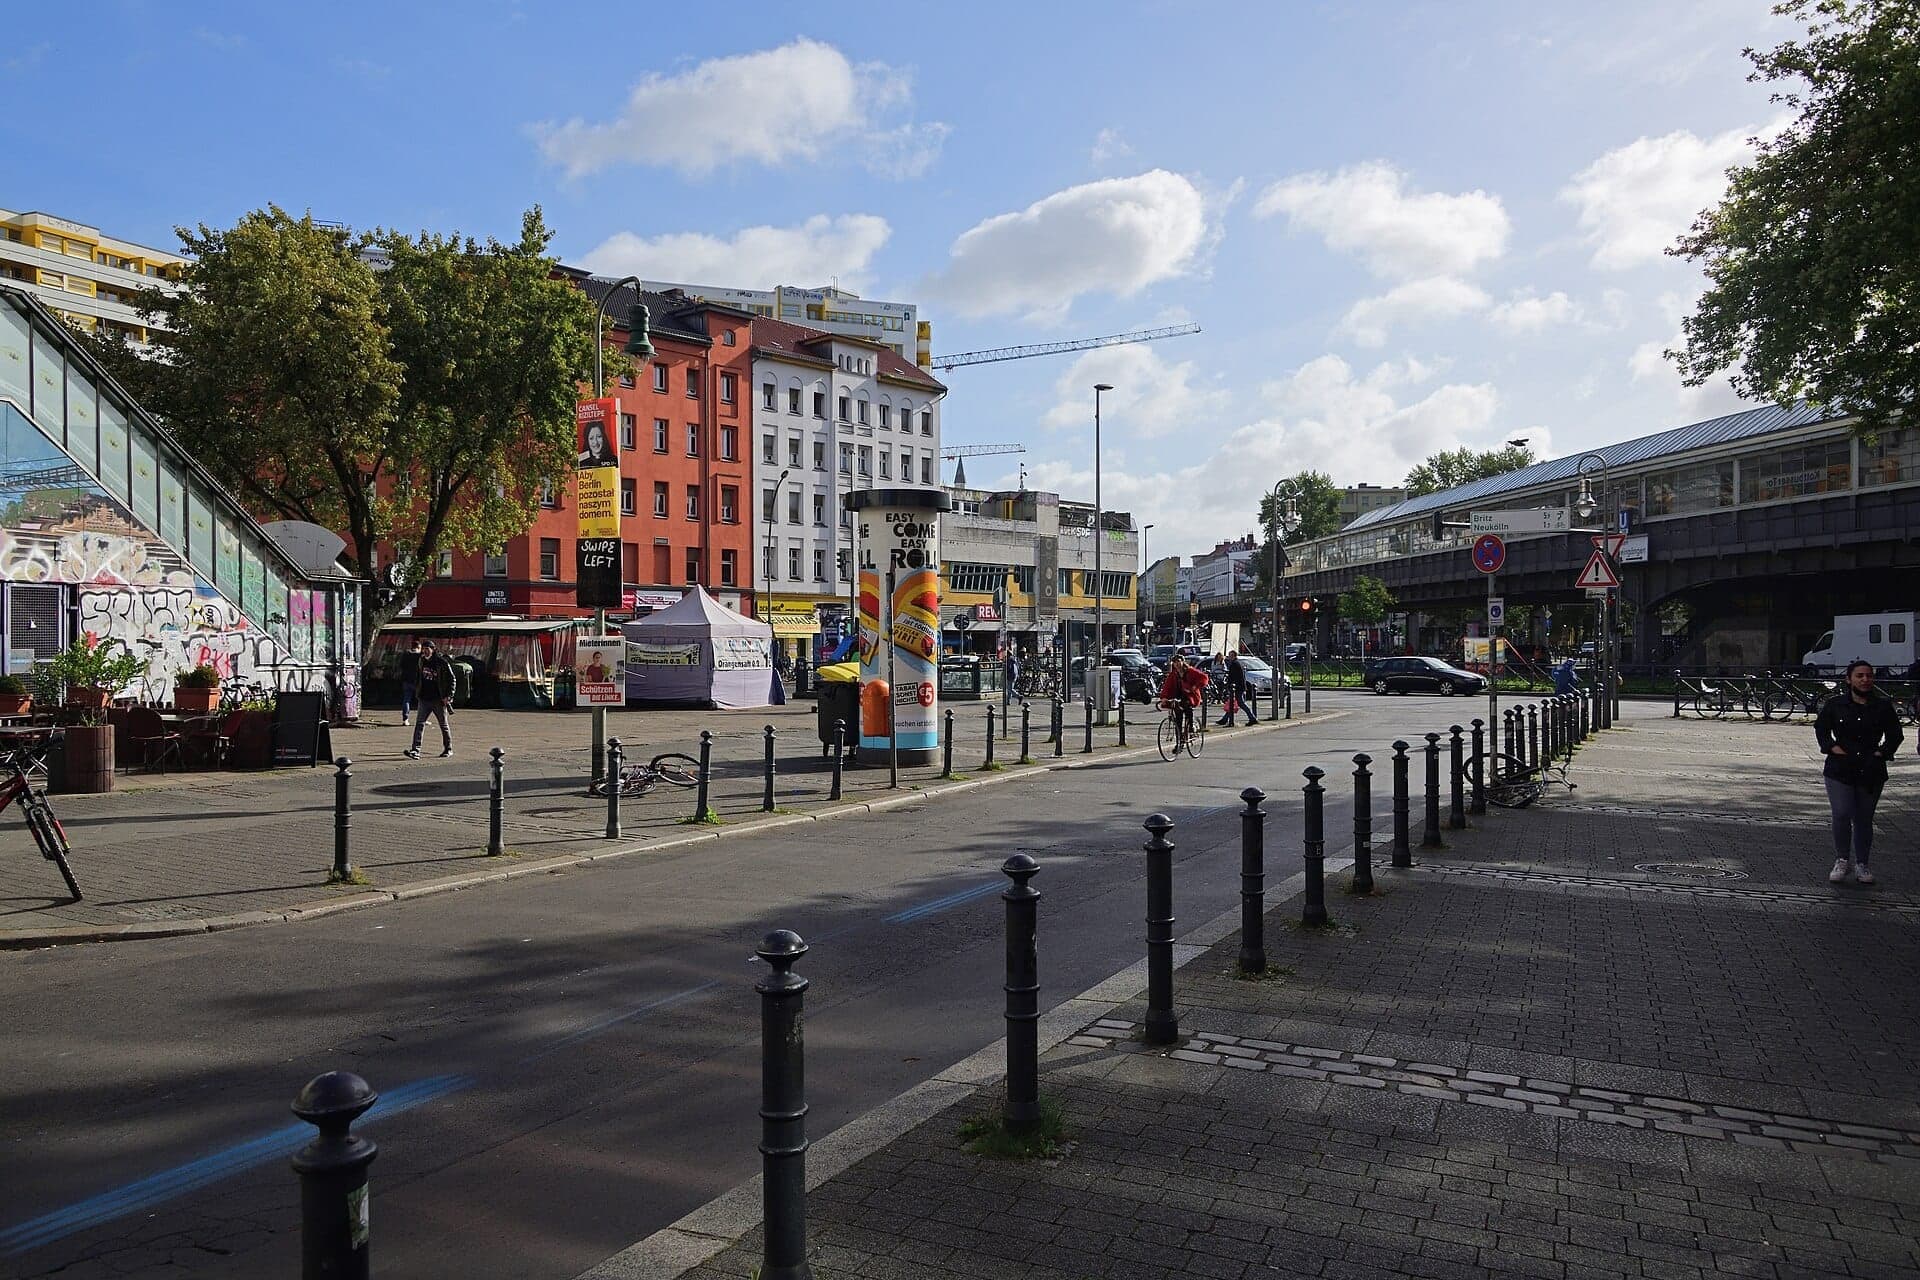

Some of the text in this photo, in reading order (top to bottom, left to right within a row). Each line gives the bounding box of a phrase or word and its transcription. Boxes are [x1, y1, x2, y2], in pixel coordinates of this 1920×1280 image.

[579, 403, 599, 412] CANSEL
[579, 470, 593, 480] Aby
[579, 480, 601, 490] Berlin
[579, 500, 611, 510] naszym
[579, 510, 614, 519] domem.
[886, 512, 915, 522] EASY
[1473, 514, 1492, 522] Britz
[1619, 511, 1627, 527] U
[893, 523, 936, 538] COME
[1473, 522, 1509, 531] Neukölln
[581, 540, 616, 553] SWIPE
[901, 539, 927, 548] EASY
[584, 554, 615, 568] LEFT
[979, 605, 999, 618] REW
[894, 629, 917, 645] PIRIT
[631, 656, 668, 665] Orangensaft
[718, 659, 751, 670] Orangensaft
[580, 685, 614, 694] Schützen
